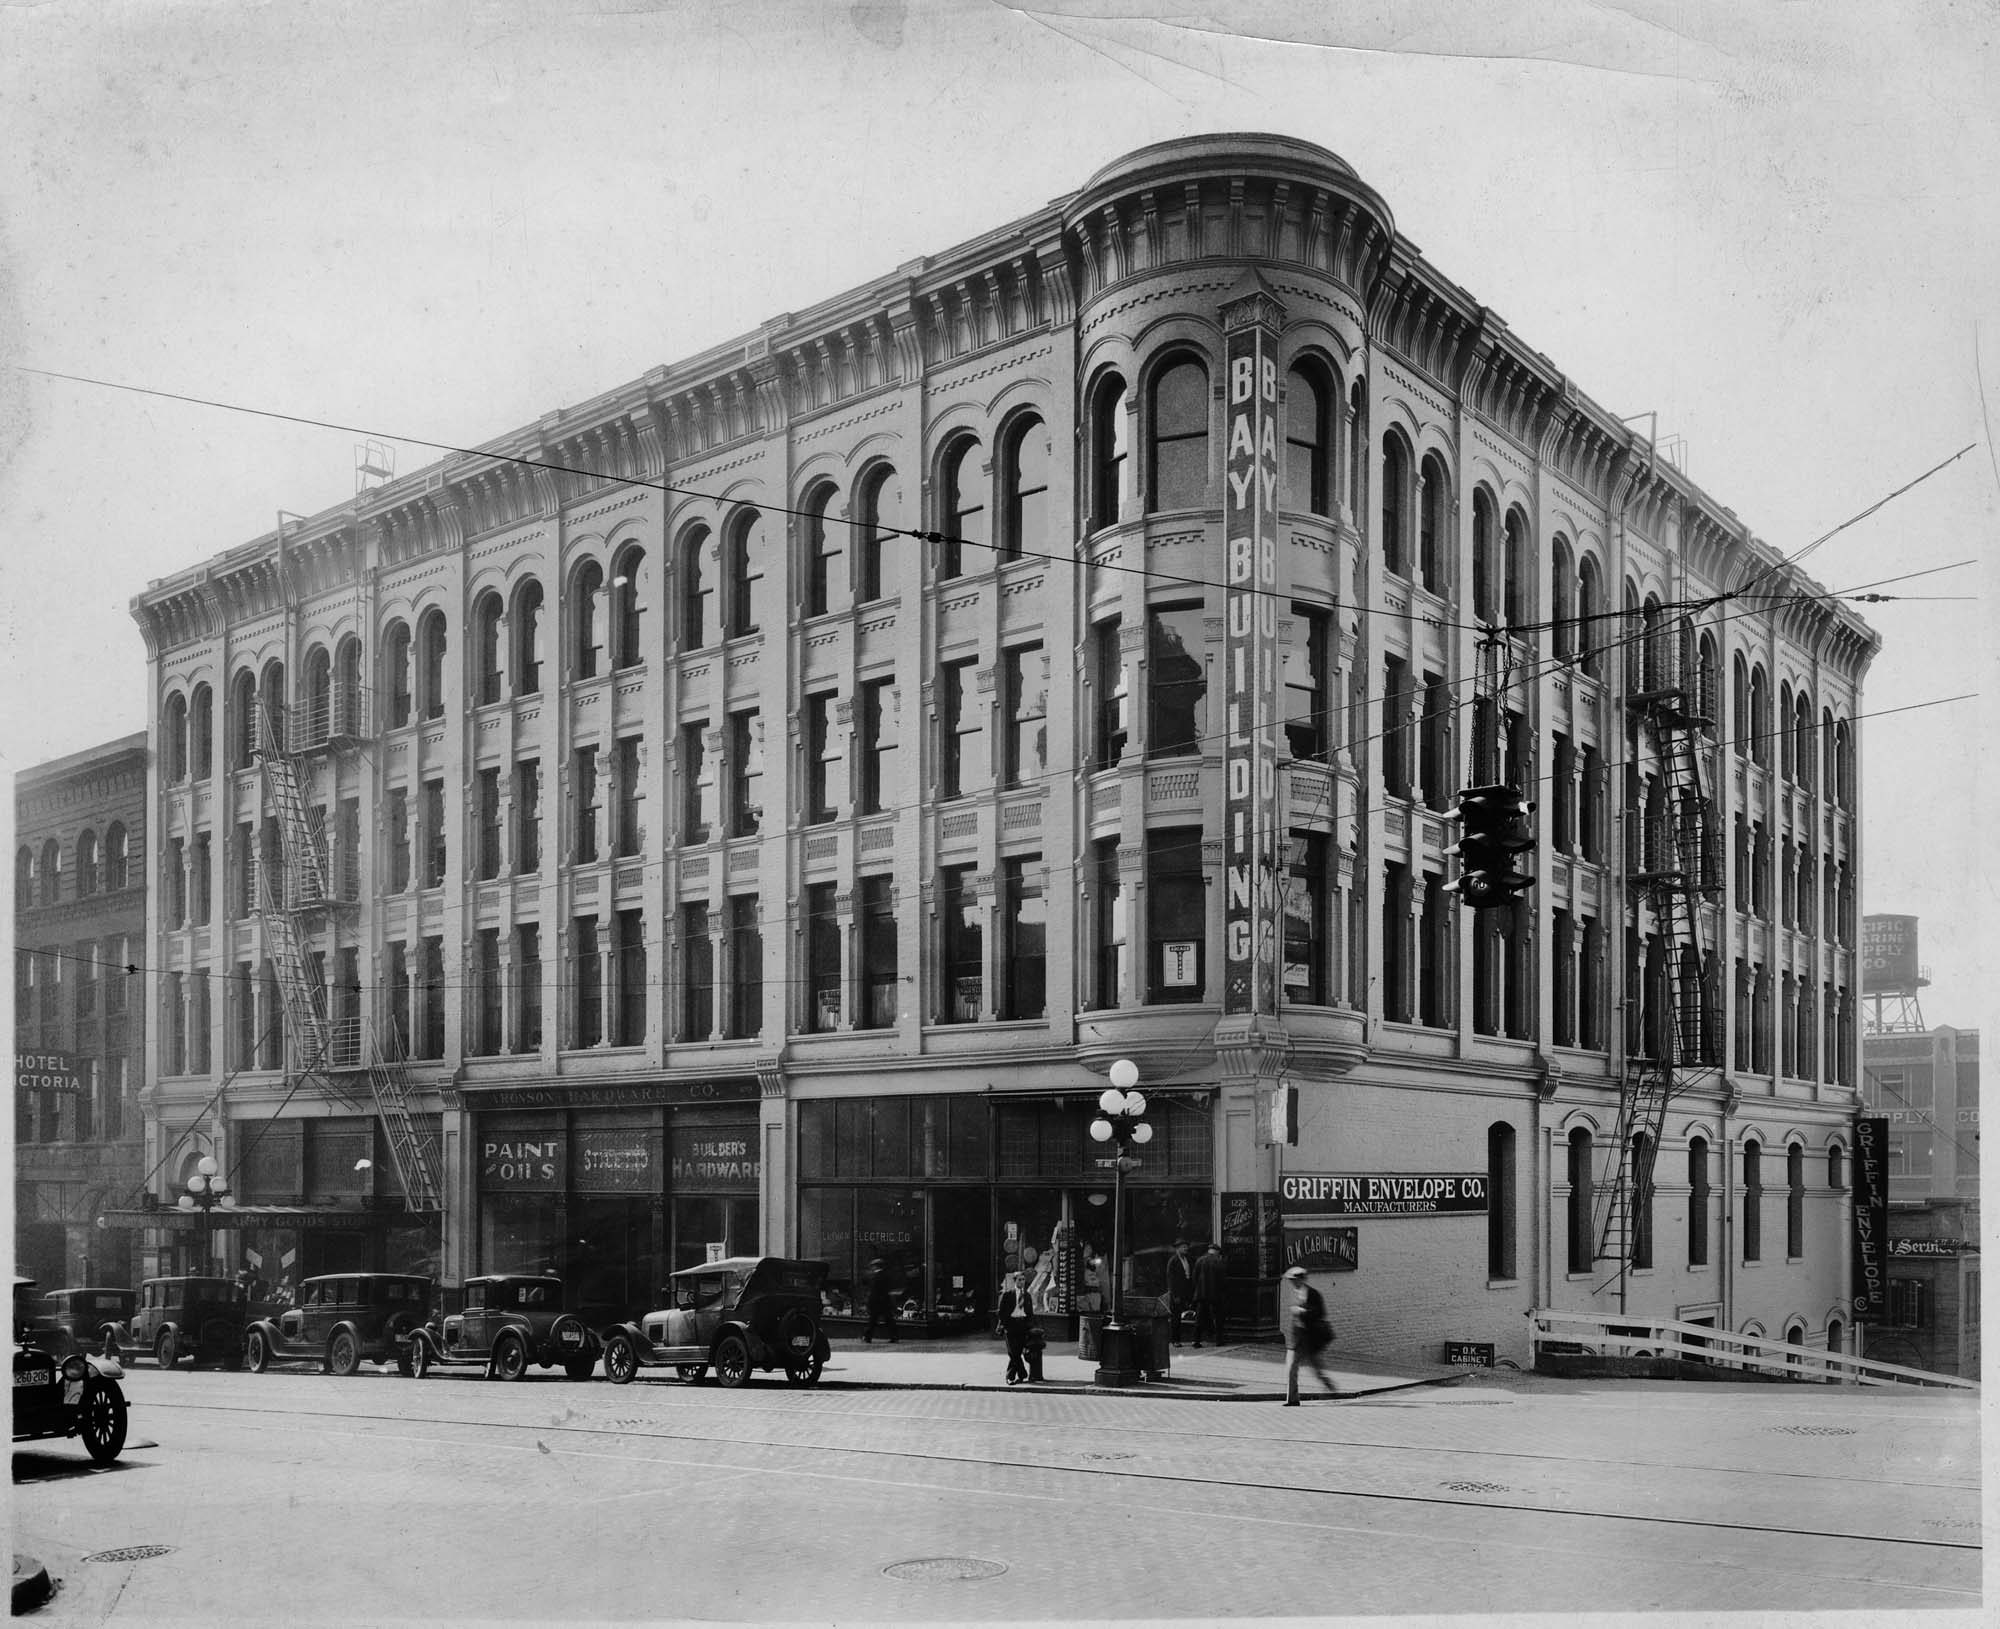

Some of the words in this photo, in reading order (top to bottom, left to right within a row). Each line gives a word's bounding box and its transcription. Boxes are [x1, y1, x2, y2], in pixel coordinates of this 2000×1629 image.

[1228, 356, 1255, 510] BAY
[1261, 355, 1276, 513] BAY
[1228, 536, 1251, 962] BUILDING
[13, 1055, 70, 1071] HOTEL
[485, 1142, 558, 1159] PAINT
[672, 1157, 761, 1178] HARDWARE
[1856, 1122, 1883, 1208] GRIFFIN
[1283, 1177, 1361, 1200] GRIFFIN
[1368, 1178, 1456, 1199] ENVELOPE
[1461, 1178, 1485, 1198] CO.
[1343, 1200, 1437, 1213] MANUFACTURERS
[275, 1215, 326, 1227] GOODS
[853, 1231, 895, 1242] ELECTRIC
[1304, 1235, 1338, 1255] CABINET
[1855, 1205, 1883, 1303] ENVELOPE
[1894, 1238, 1953, 1256] Servi
[1451, 1354, 1488, 1364] CABINET
